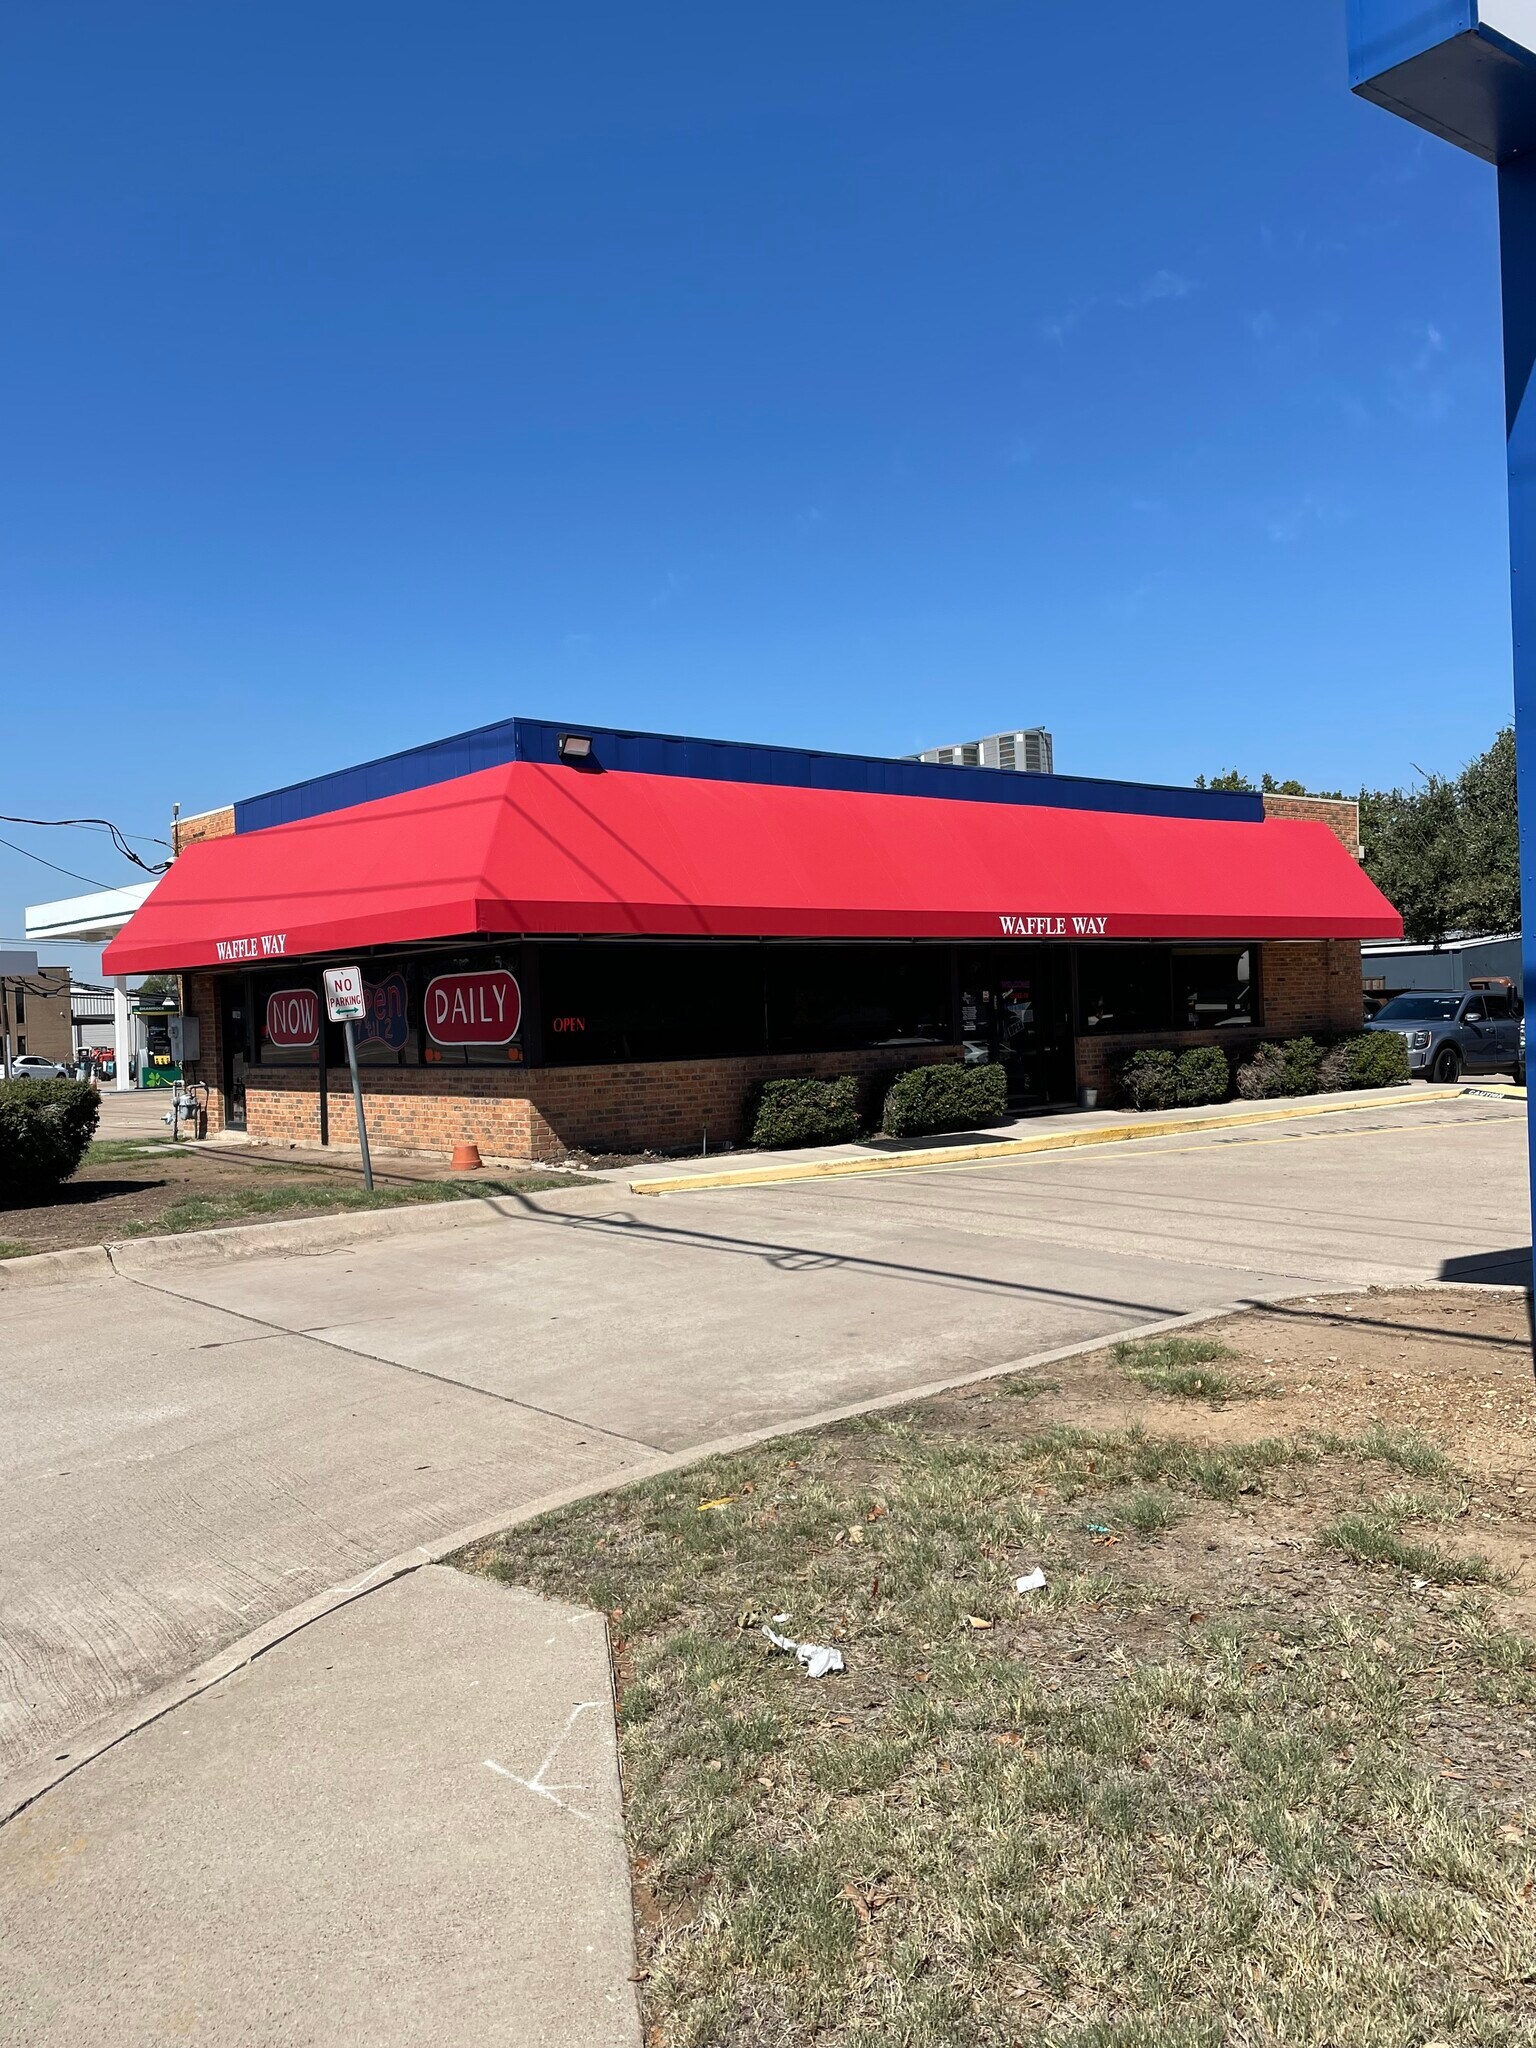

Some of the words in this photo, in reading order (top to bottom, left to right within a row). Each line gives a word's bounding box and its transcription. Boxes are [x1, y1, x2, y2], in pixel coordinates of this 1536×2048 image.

[999, 916, 1066, 934] WAFFLE
[1072, 917, 1107, 934] WAY
[216, 938, 258, 960] WAFFLE
[261, 934, 286, 955] WAY
[334, 979, 352, 992] NO
[330, 995, 361, 1007] PARKING
[435, 984, 506, 1024] DAILY
[273, 999, 314, 1034] NOW
[553, 1017, 585, 1032] OPEN
[384, 1018, 393, 1039] 2
[1469, 1090, 1505, 1099] CAUTION
